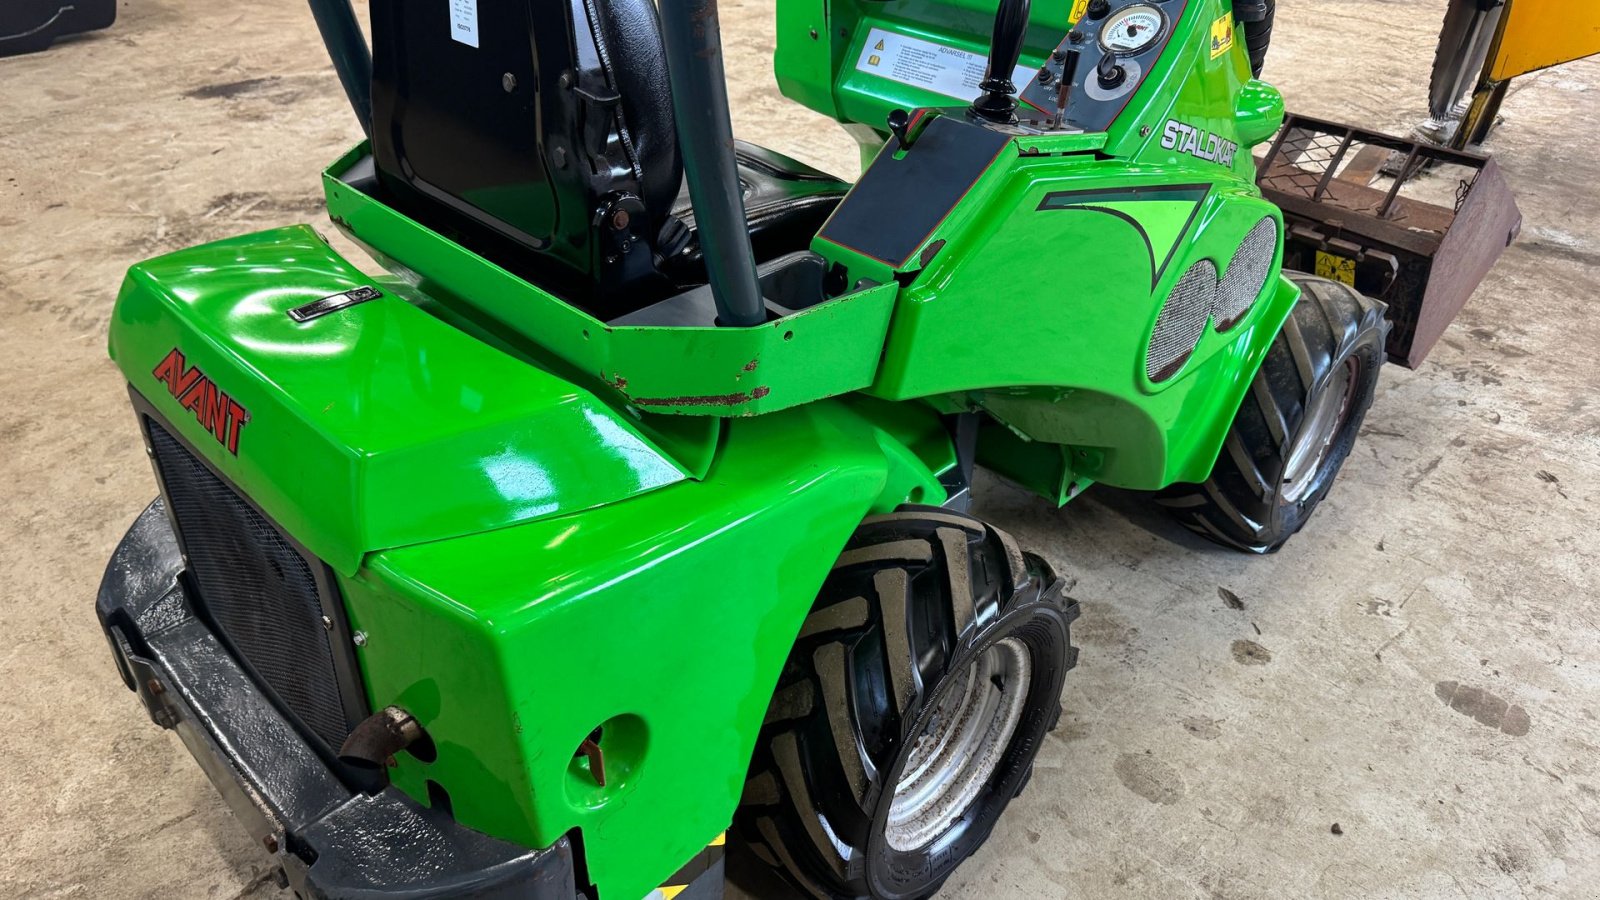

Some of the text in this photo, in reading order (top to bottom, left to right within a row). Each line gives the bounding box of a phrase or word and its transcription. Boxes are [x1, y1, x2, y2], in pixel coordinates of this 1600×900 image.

[938, 47, 966, 59] ADVARSEL
[1160, 118, 1238, 168] STALDKAT
[152, 347, 247, 458] AVANT
